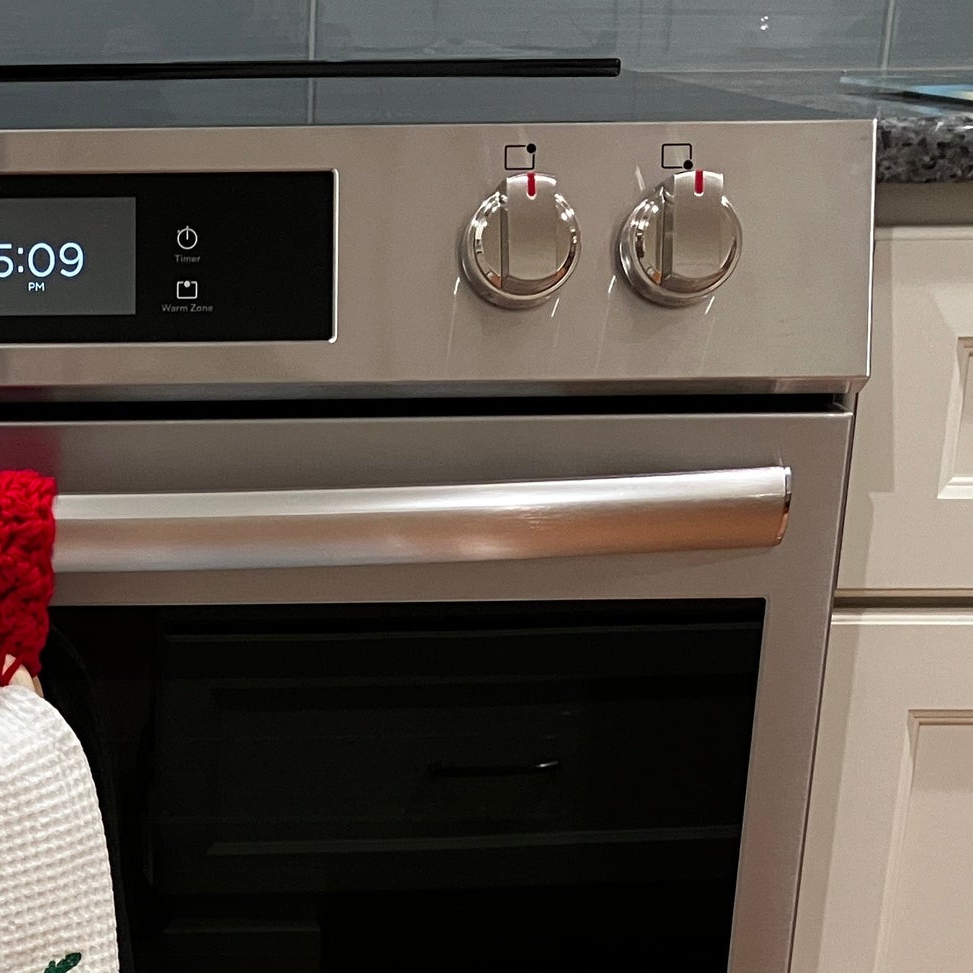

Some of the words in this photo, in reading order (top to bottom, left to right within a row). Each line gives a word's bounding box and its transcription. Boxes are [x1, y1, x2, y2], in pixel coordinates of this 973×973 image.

[174, 254, 201, 263] Timer
[28, 281, 45, 292] PM
[161, 303, 188, 312] Warm
[190, 303, 214, 312] Zone
